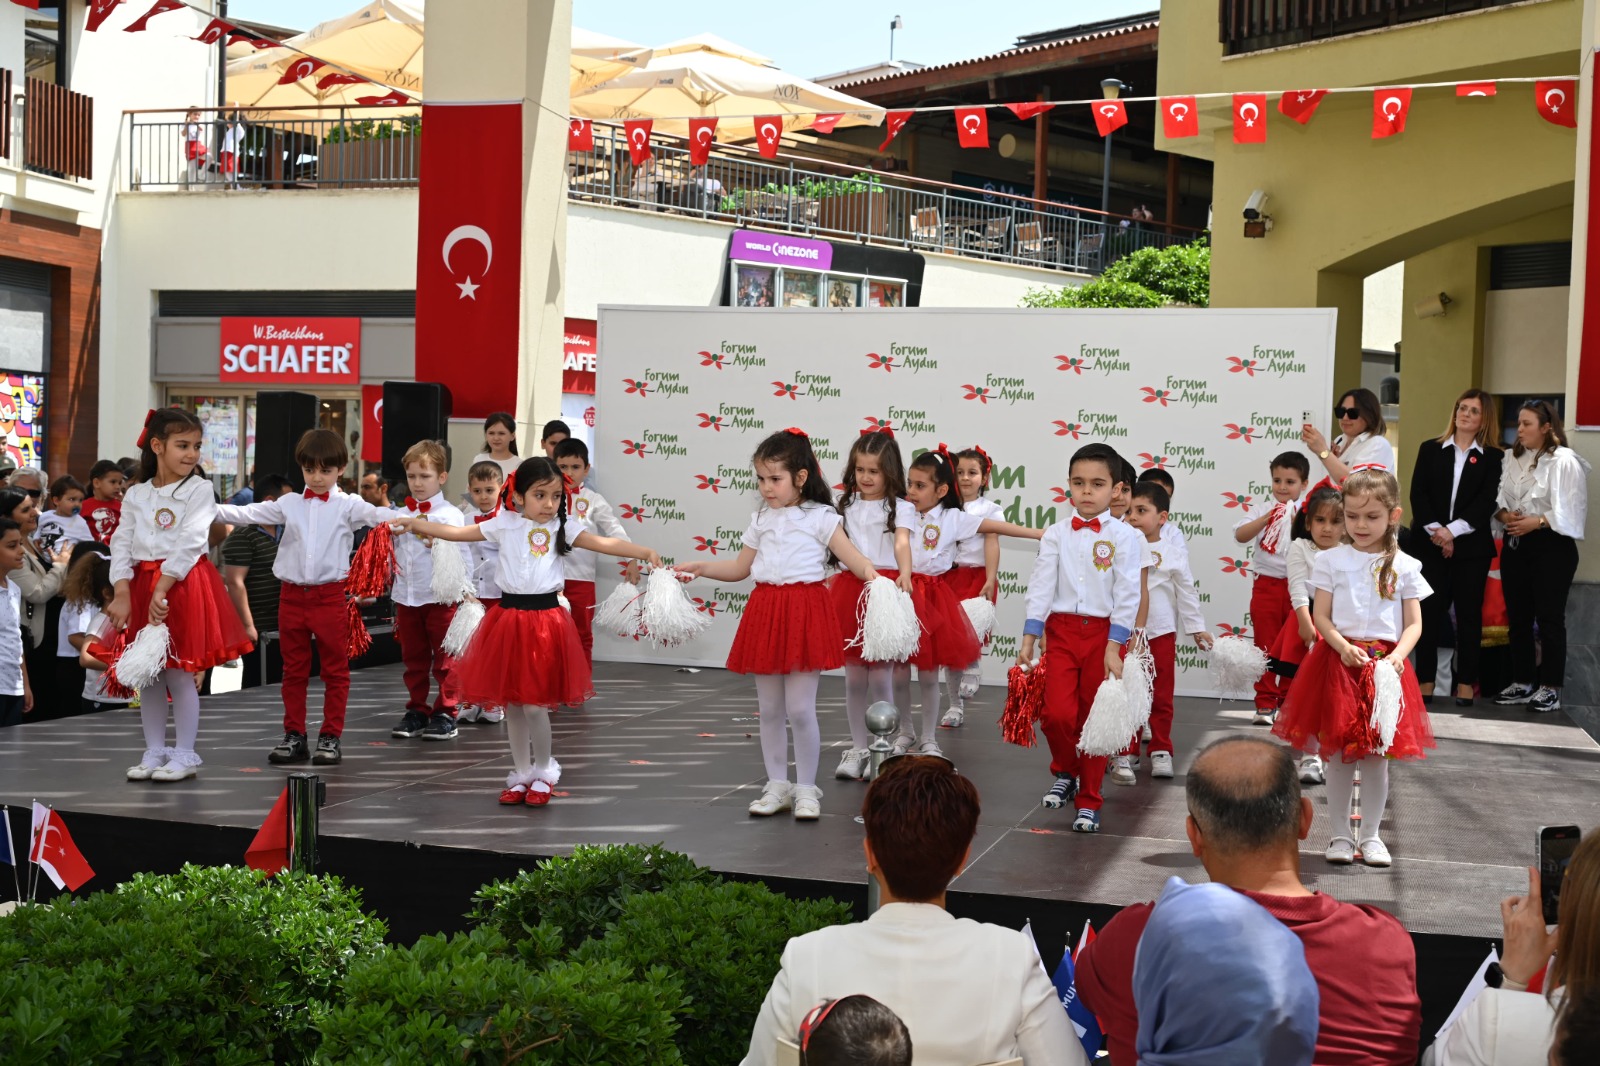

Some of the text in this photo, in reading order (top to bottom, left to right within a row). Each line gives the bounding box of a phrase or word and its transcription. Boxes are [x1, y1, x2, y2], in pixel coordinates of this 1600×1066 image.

[745, 242, 771, 252] WORLD
[722, 341, 757, 354] Forum
[891, 342, 928, 356] Forum
[1080, 344, 1119, 358] Forum
[1253, 345, 1294, 359] Forum
[733, 354, 766, 371] Aydın
[903, 355, 938, 374] Aydın
[1094, 358, 1130, 376] Aydın
[1267, 359, 1306, 378] Aydın
[646, 369, 679, 381] Forum
[795, 371, 831, 384] Forum
[987, 374, 1024, 387] Forum
[657, 381, 688, 399] Aydın
[1167, 376, 1207, 390] Forum
[807, 384, 841, 402] Aydın
[999, 388, 1034, 405] Aydın
[1180, 390, 1217, 408] Aydın
[720, 403, 754, 415] Forum
[889, 407, 926, 419] Forum
[1078, 410, 1117, 423] Forum
[1251, 412, 1292, 426] Forum
[731, 416, 764, 433] Aydın
[901, 419, 935, 437] Aydın
[644, 430, 678, 443] Forum
[1091, 423, 1127, 441] Aydın
[1265, 426, 1303, 445] Aydın
[655, 443, 687, 460] Aydın
[1165, 442, 1204, 456] Forum
[718, 465, 752, 477] Forum
[1177, 456, 1215, 475] Aydın
[642, 494, 676, 507] Forum
[653, 507, 685, 524] Aydın
[997, 495, 1057, 530] dın
[1168, 512, 1202, 522] orum
[716, 526, 743, 539] Foru
[714, 588, 749, 601] Forum
[991, 635, 1016, 645] rum
[991, 646, 1021, 663] Aydı
